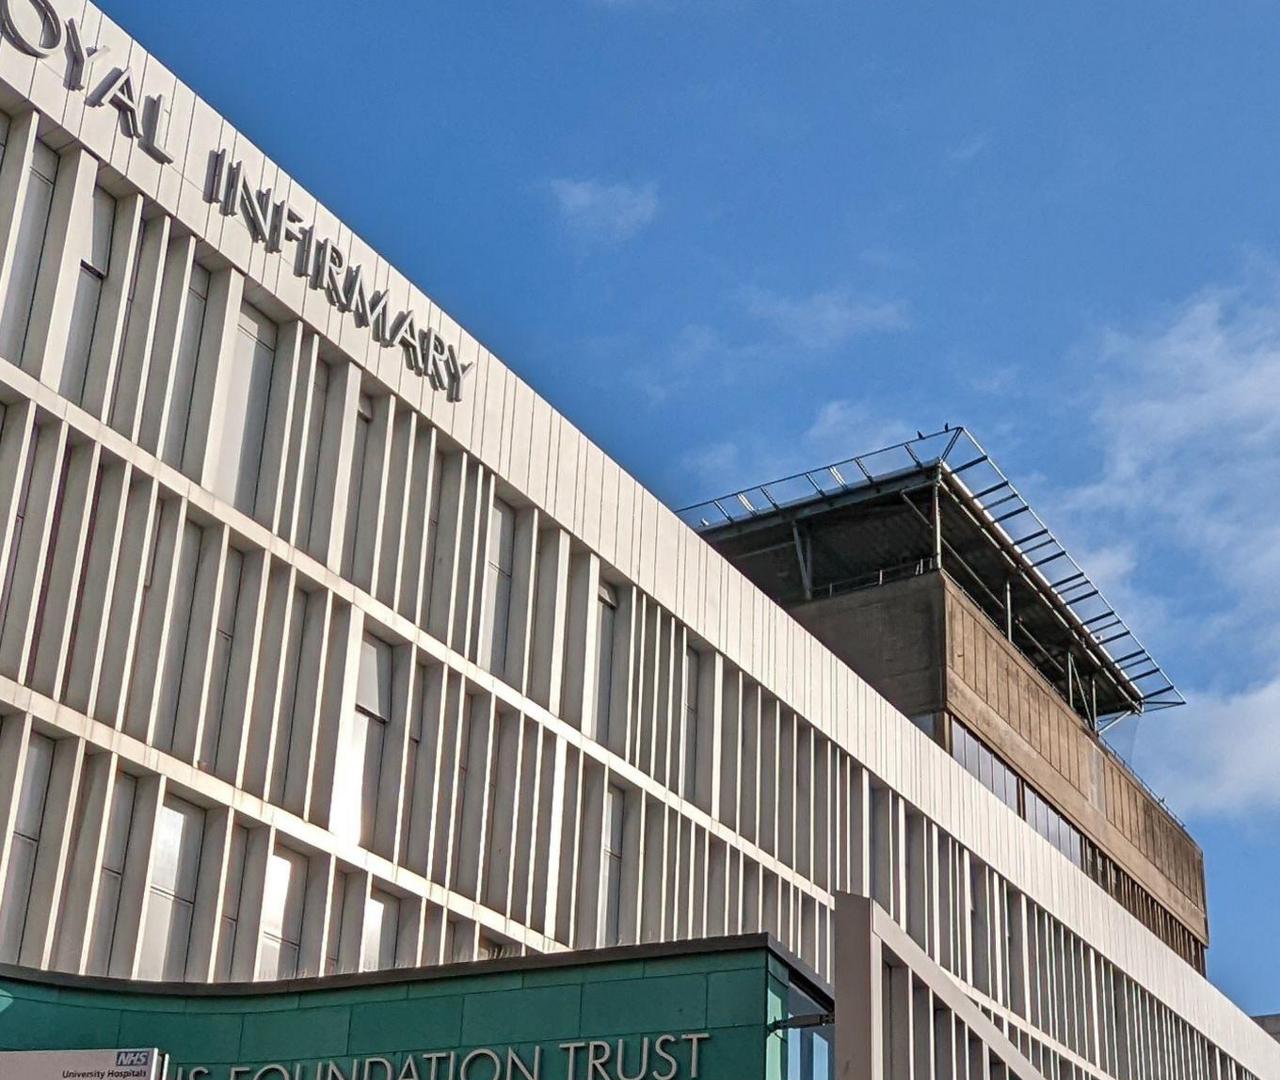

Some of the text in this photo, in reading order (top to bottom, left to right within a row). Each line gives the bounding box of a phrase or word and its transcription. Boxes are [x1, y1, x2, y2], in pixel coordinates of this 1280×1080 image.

[204, 148, 475, 402] INFIRMARY
[117, 1052, 148, 1066] NHS
[62, 1069, 147, 1080] University Hospitals
